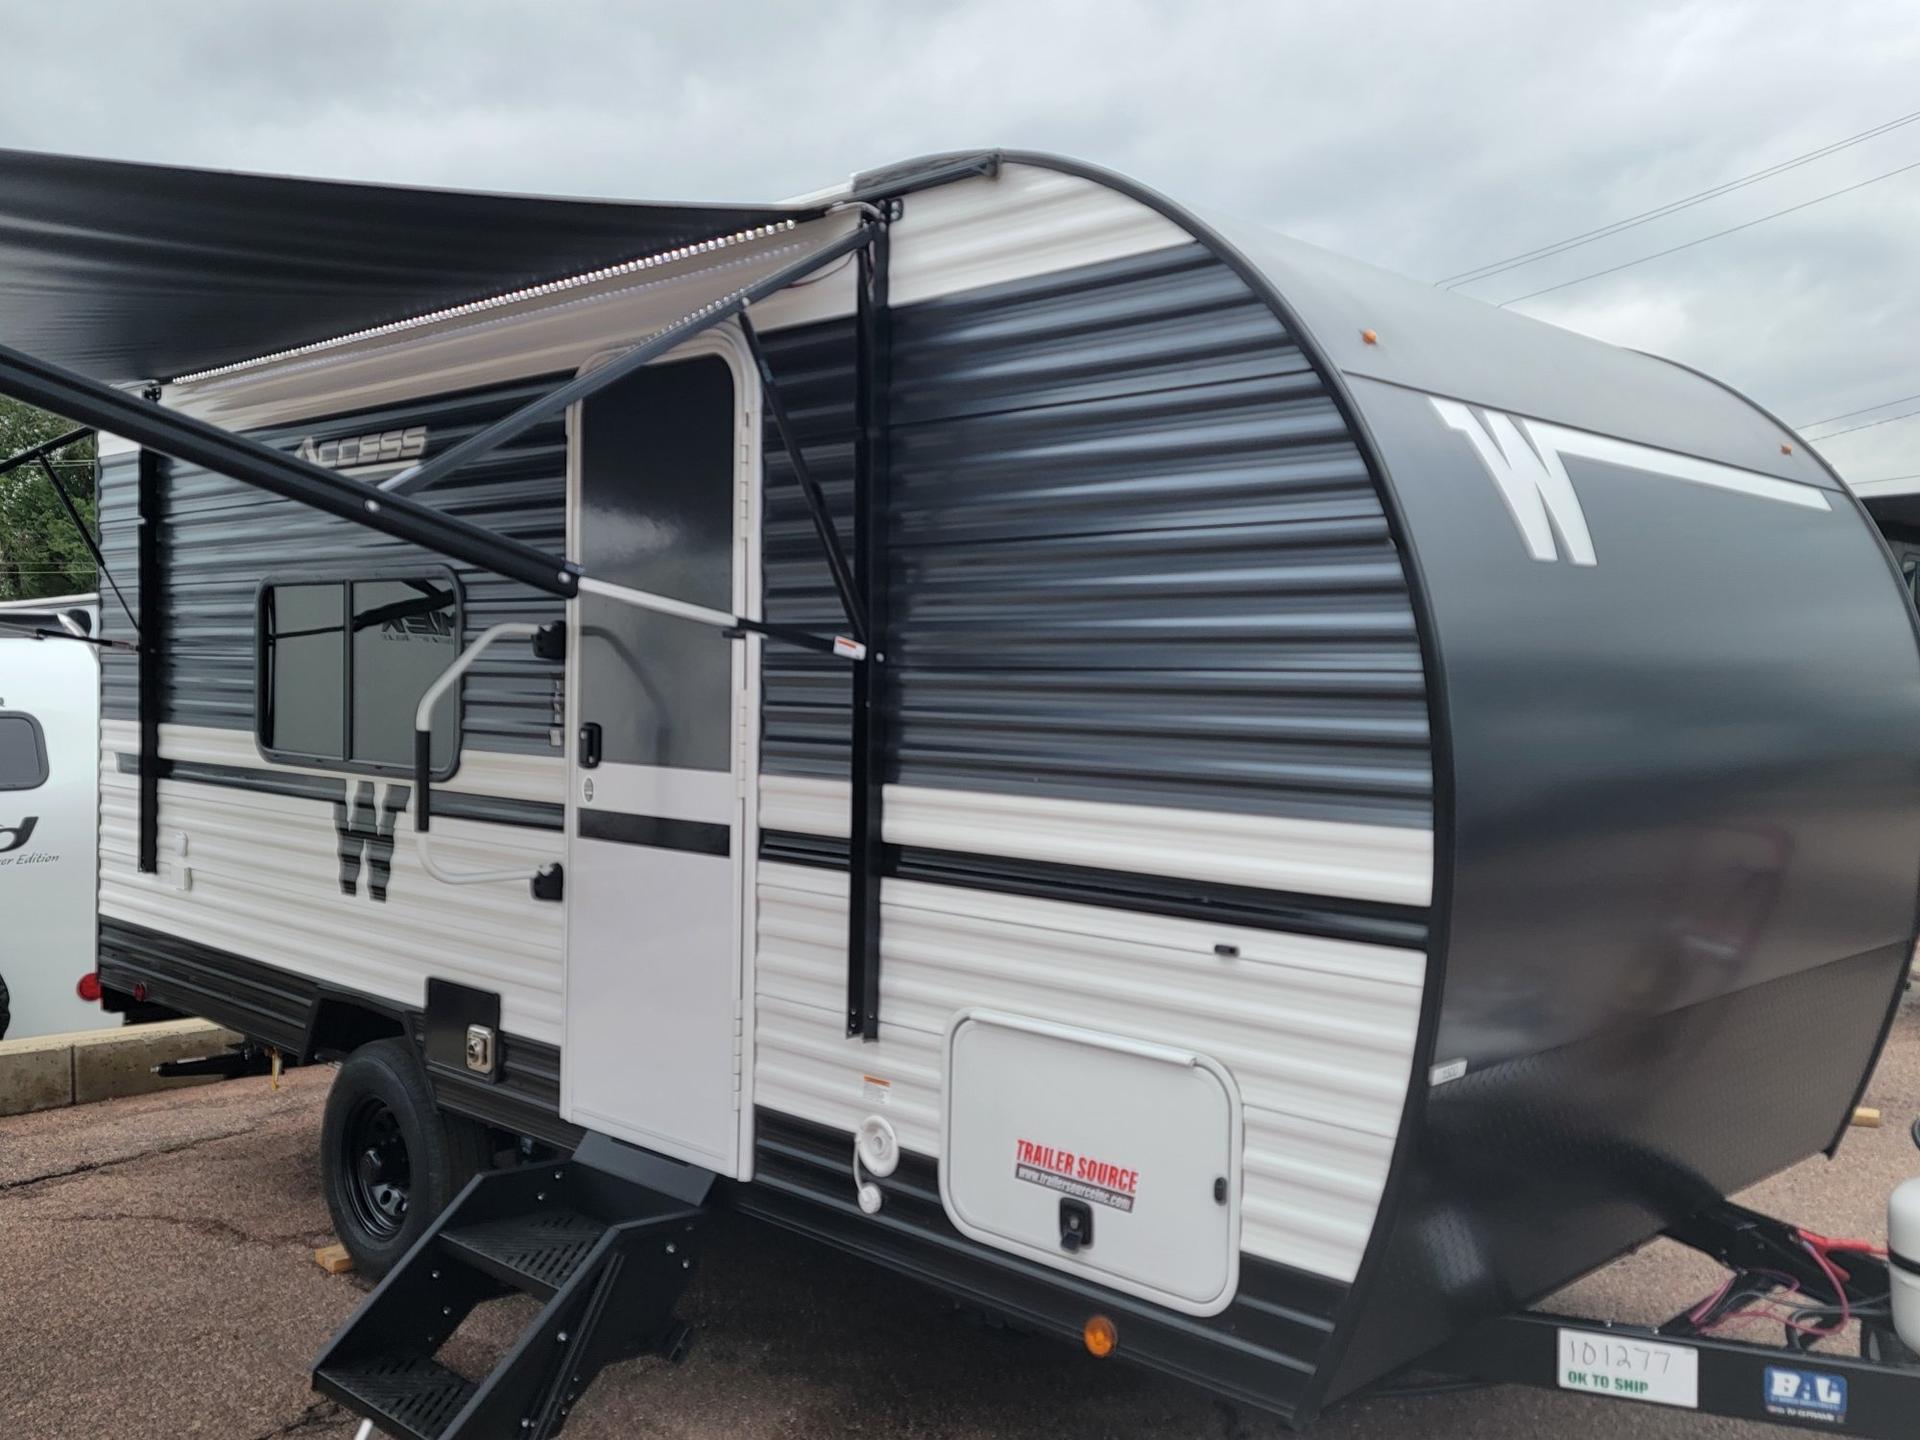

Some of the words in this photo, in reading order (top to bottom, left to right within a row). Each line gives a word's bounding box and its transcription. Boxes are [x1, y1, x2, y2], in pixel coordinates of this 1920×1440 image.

[294, 426, 427, 467] ACCESS
[16, 852, 60, 865] Edition
[1016, 1139, 1075, 1176] TRAILER
[1077, 1156, 1139, 1194] SOURCE
[1570, 1340, 1671, 1374] 101277
[1567, 1370, 1588, 1386] OK
[1591, 1373, 1610, 1389] TO
[1615, 1377, 1649, 1394] SHIP
